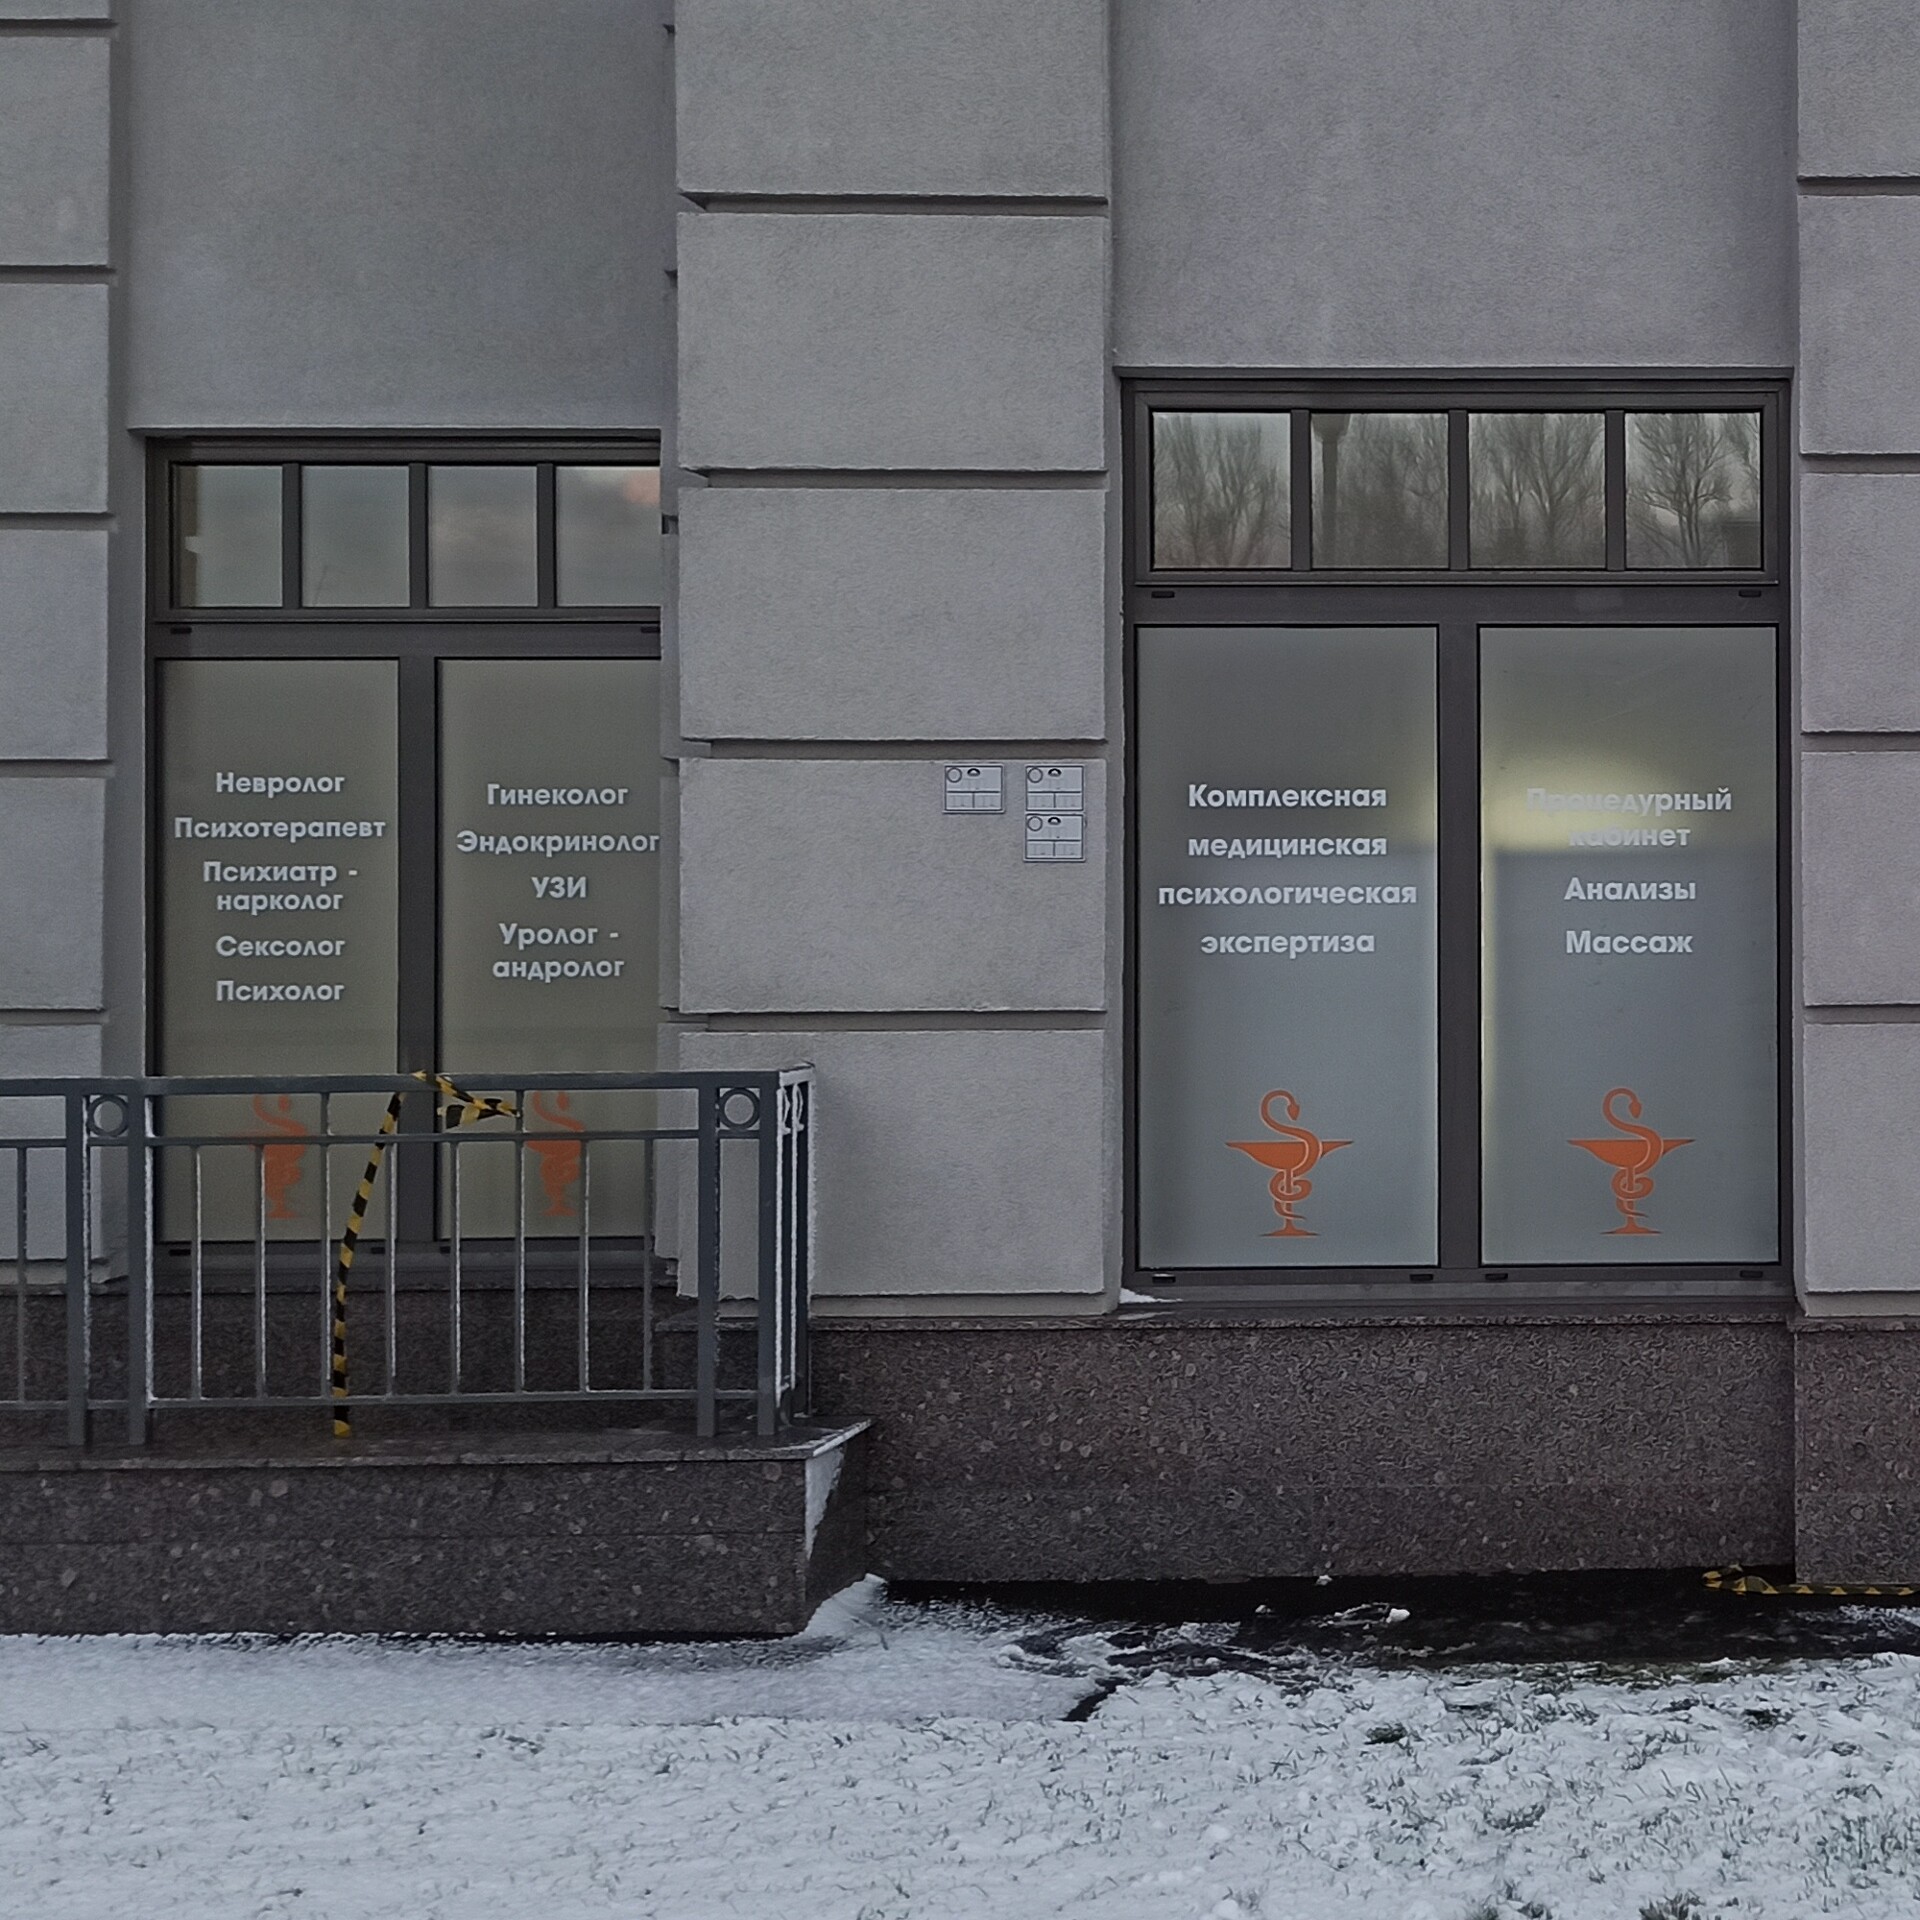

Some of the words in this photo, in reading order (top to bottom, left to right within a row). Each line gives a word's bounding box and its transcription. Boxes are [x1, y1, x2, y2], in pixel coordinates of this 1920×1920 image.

[215, 771, 346, 799] Невролог
[487, 783, 629, 806] Гинеколог
[1188, 783, 1388, 808] Комплексная
[1526, 787, 1733, 817] Процедурный
[174, 816, 387, 844] Психотерапевт
[1568, 825, 1692, 848] кабинет
[456, 829, 660, 858] Эндокринолог
[1188, 837, 1388, 861] медицинская
[203, 860, 337, 888] Психиатр
[530, 876, 588, 900] УЗИ
[1158, 885, 1418, 907] психологическая
[1563, 876, 1697, 902] Анализы
[216, 893, 344, 917] нарколог
[215, 935, 346, 958] Сексолог
[498, 922, 599, 951] Уролог
[1200, 934, 1376, 960] экспертиза
[1566, 930, 1694, 955] Массаж
[492, 960, 626, 984] андролог
[216, 980, 345, 1003] Психолог
